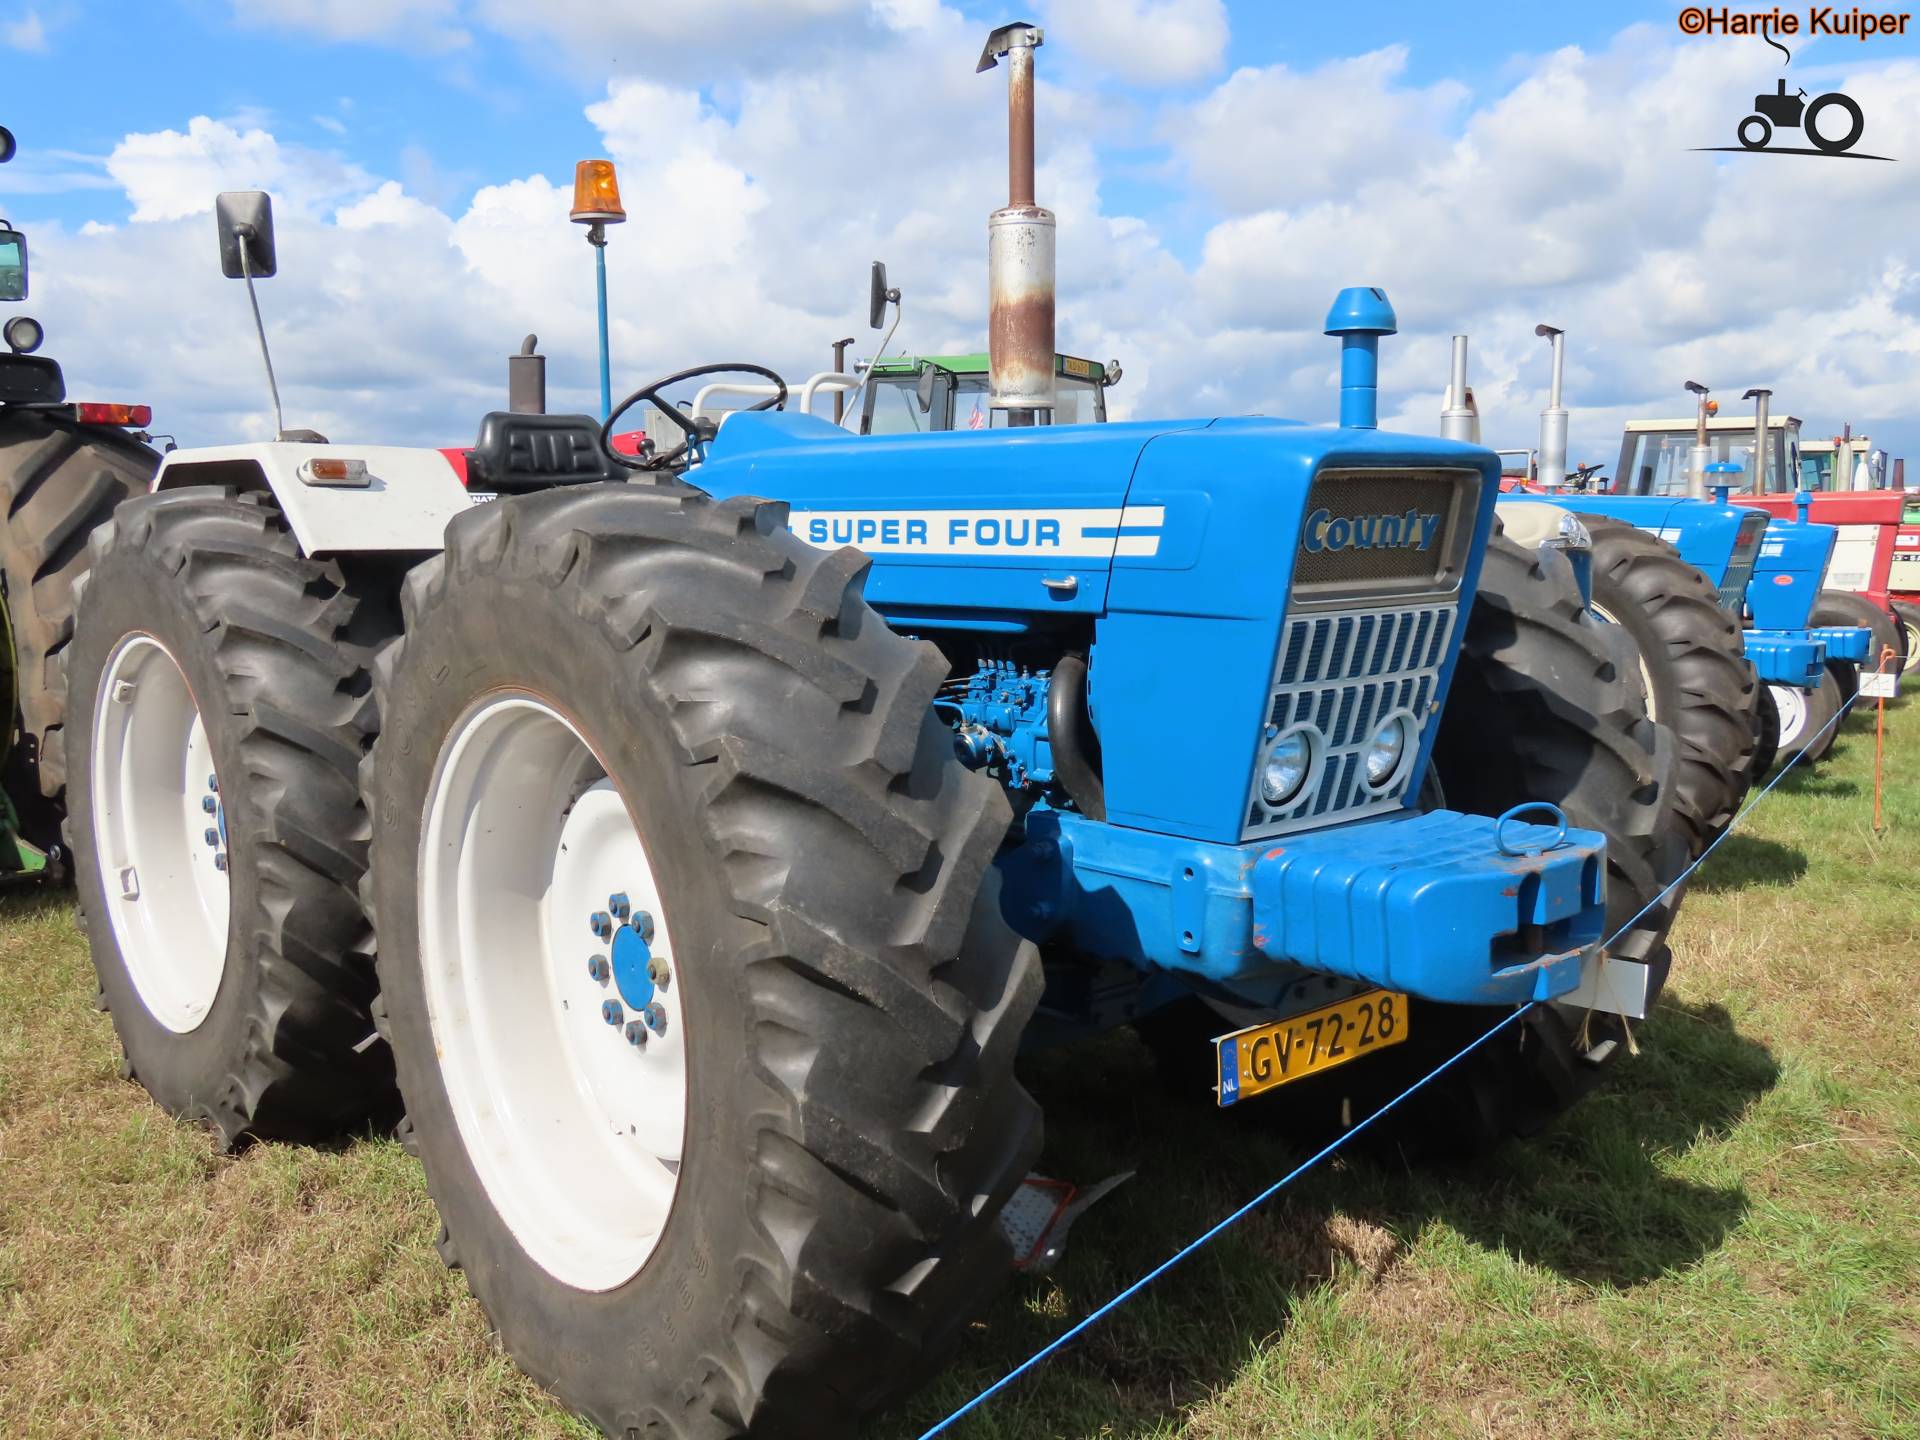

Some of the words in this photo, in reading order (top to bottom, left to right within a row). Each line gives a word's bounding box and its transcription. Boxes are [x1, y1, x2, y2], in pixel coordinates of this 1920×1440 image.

[809, 519, 927, 544] SUPER
[949, 519, 1060, 546] FOUR
[1303, 508, 1440, 553] County
[1251, 997, 1394, 1082] GV-72-28
[1223, 1078, 1237, 1094] NL
